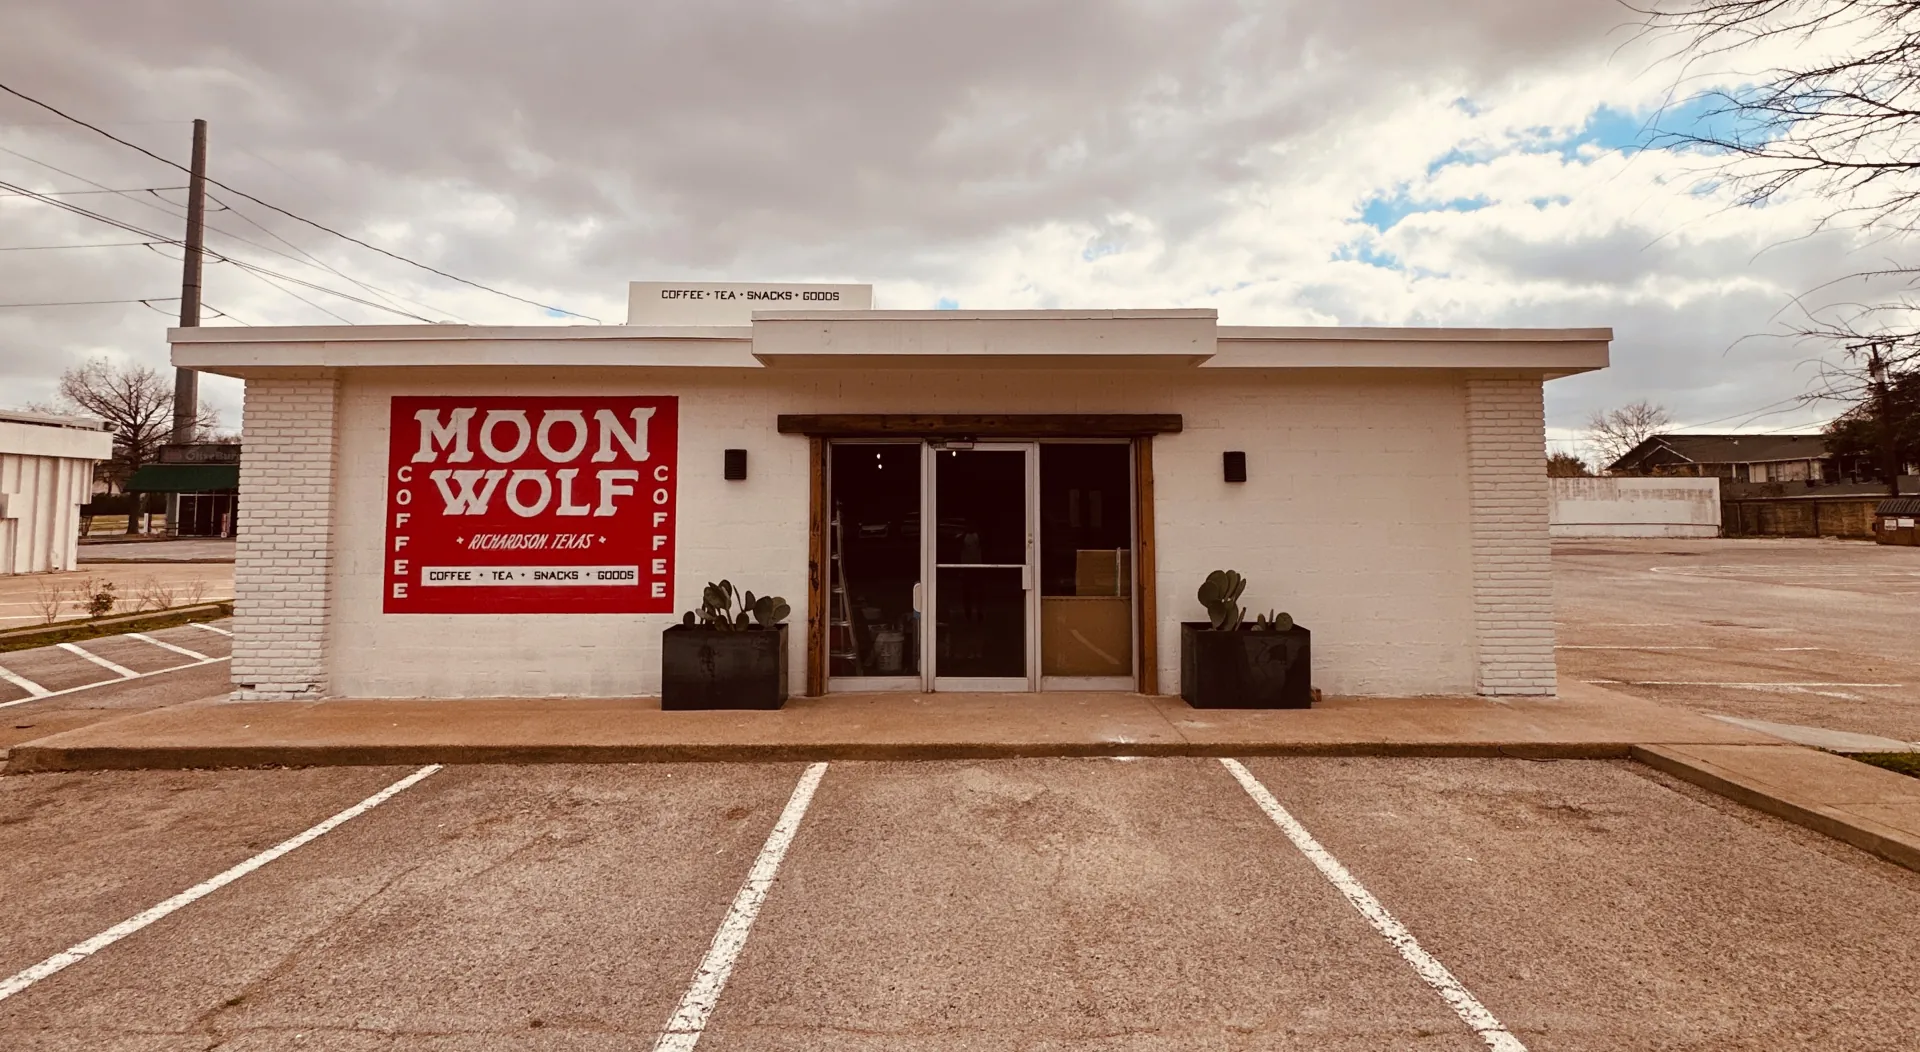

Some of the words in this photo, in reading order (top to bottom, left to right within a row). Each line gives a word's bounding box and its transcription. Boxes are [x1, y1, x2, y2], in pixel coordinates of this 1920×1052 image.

[661, 289, 704, 300] COFFEE
[714, 290, 736, 300] TEA
[747, 290, 793, 301] SNACKS
[803, 291, 840, 301] GOODS
[411, 406, 657, 464] MOON
[429, 468, 639, 518] WOLF
[393, 465, 413, 599] COFFEE
[550, 533, 595, 549] TEXAS
[651, 465, 669, 598] COFFEE
[429, 571, 471, 581] COFFEE
[492, 570, 514, 581] TEA
[533, 570, 579, 581] SNACKS
[597, 570, 634, 581] GOODS
